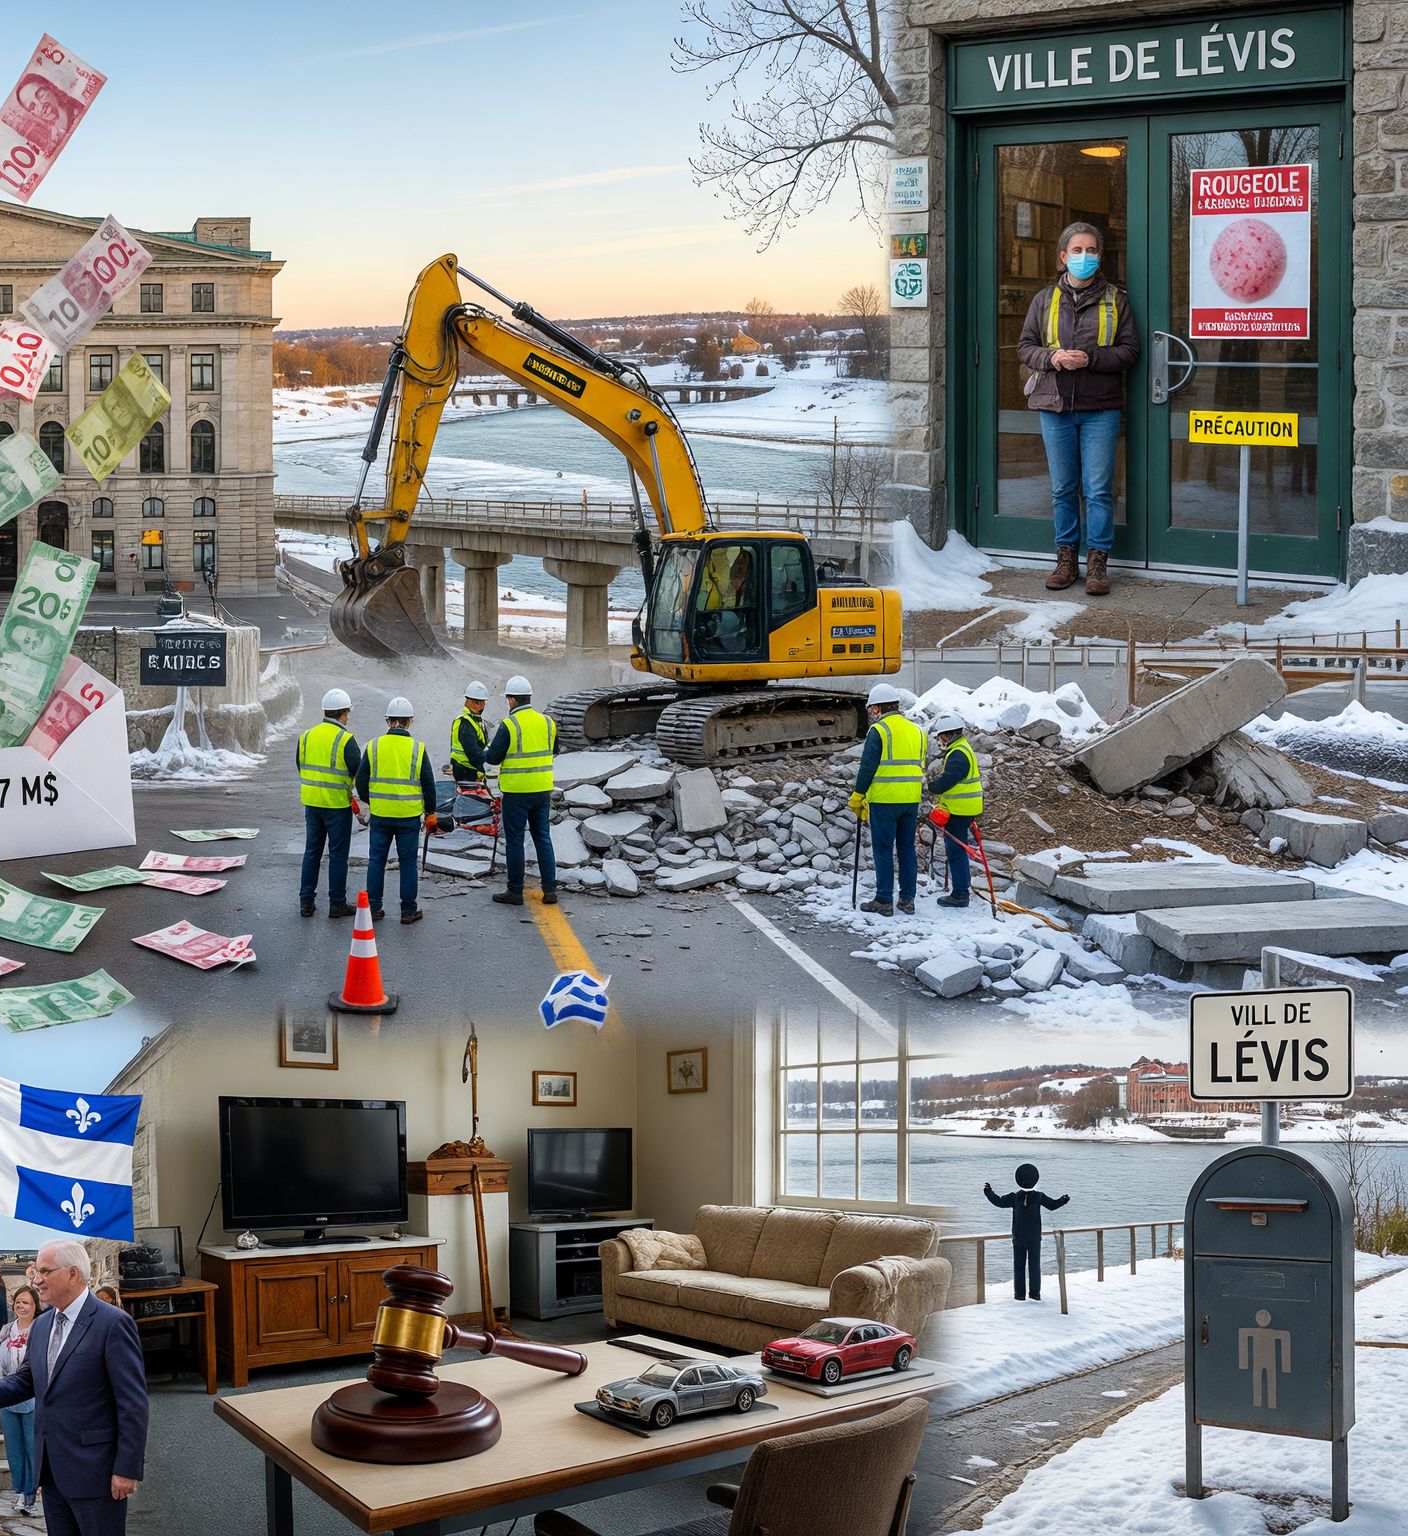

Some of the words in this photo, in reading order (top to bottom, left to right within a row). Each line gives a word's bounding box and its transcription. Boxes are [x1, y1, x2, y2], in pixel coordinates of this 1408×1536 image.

[987, 46, 1093, 92] VILLE
[1109, 39, 1160, 83] DE
[1175, 23, 1296, 78] LÉVIS
[1199, 171, 1301, 197] ROUGEOLE
[1194, 415, 1293, 438] PRÉCAUTION
[21, 771, 60, 806] M$
[1230, 1004, 1276, 1026] VILL
[1283, 1002, 1311, 1024] DE
[1210, 1029, 1330, 1083] LÉVIS
